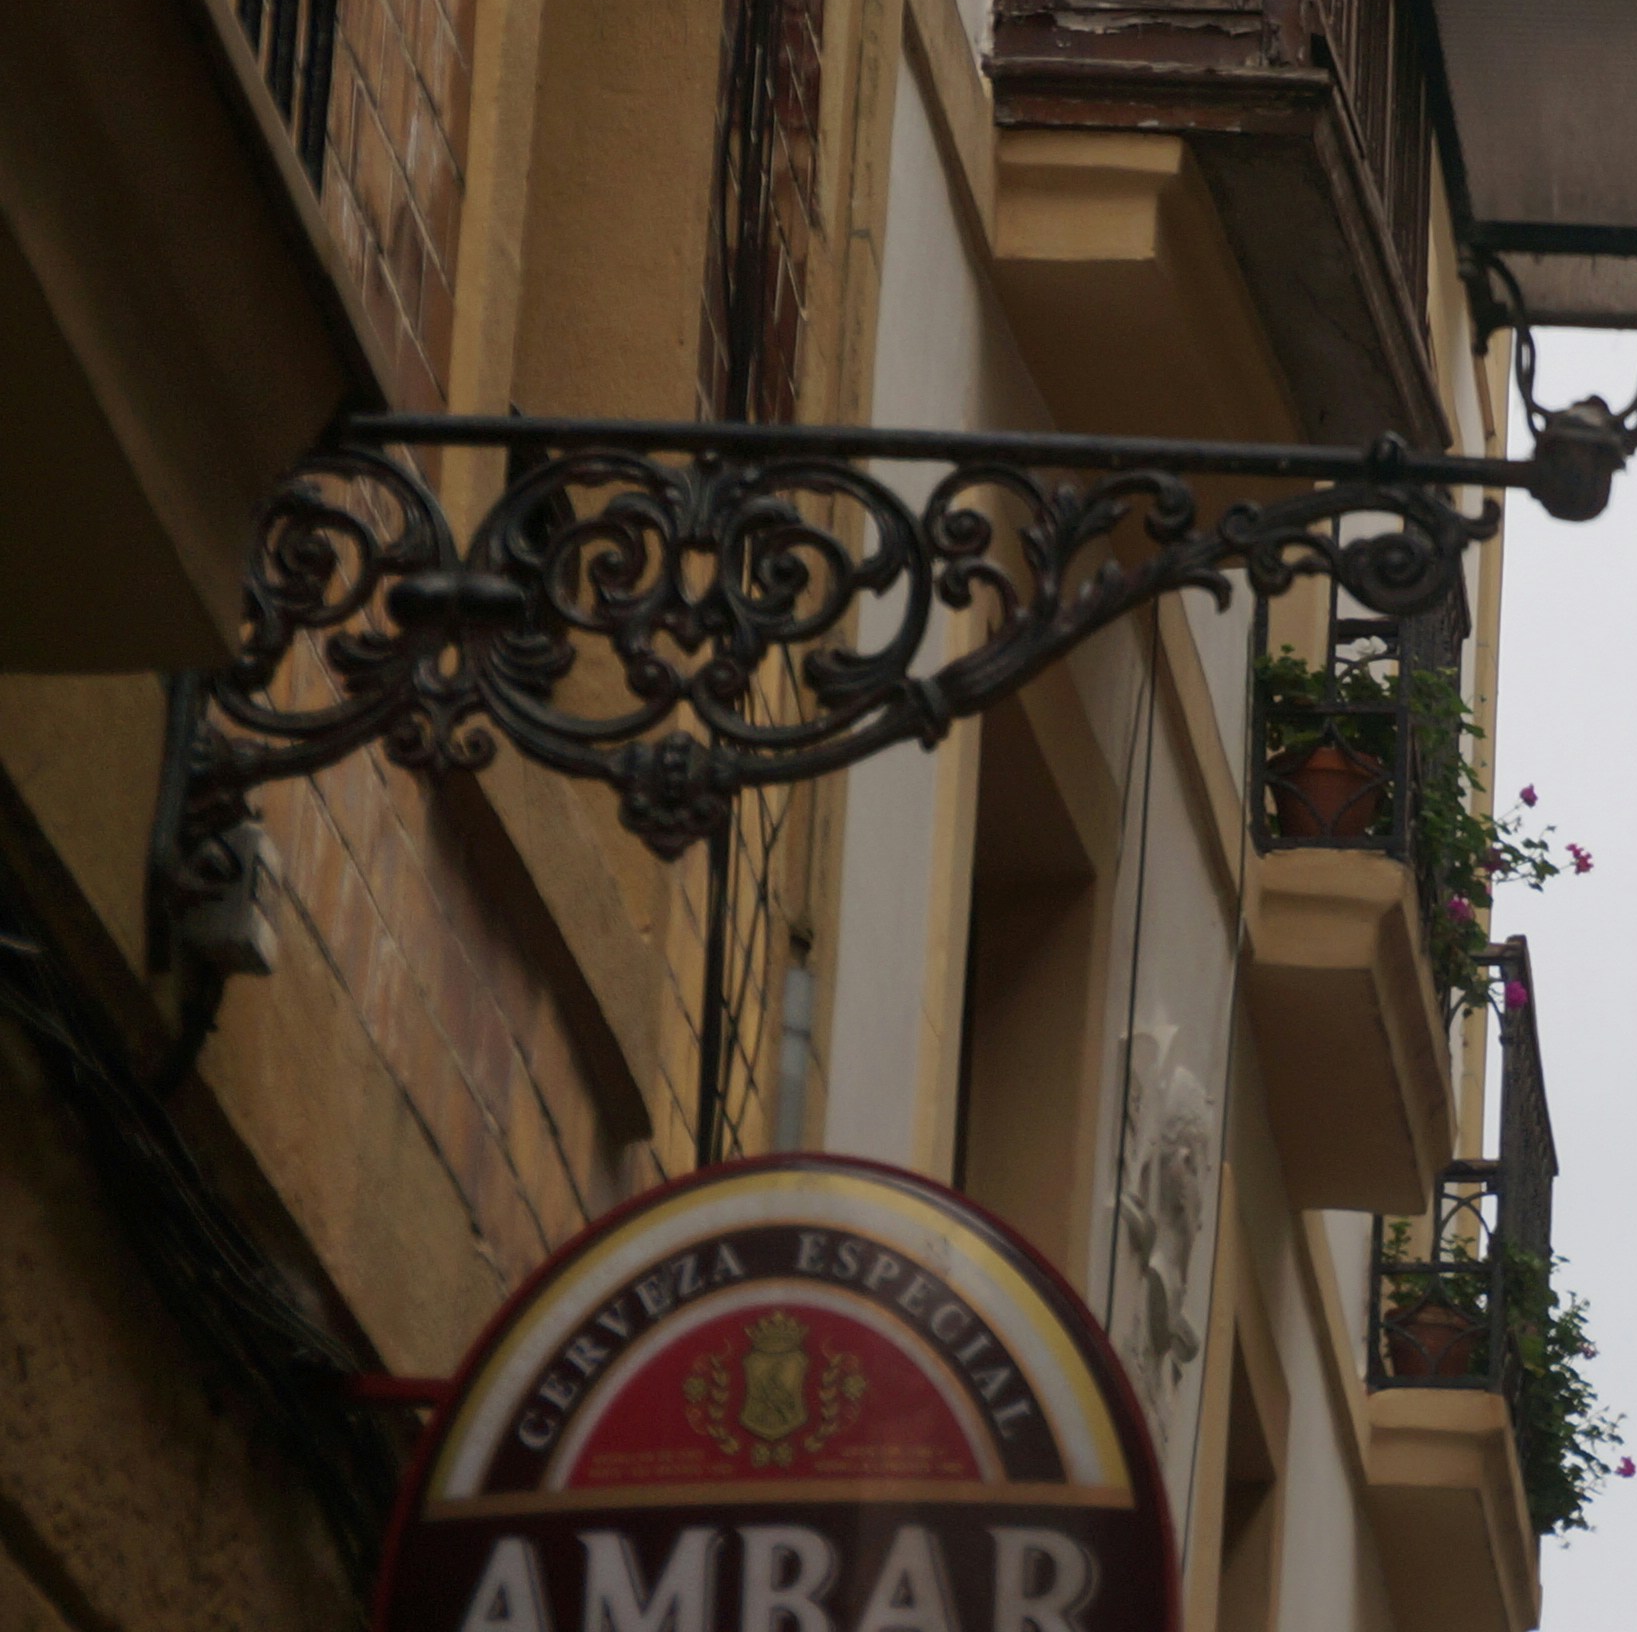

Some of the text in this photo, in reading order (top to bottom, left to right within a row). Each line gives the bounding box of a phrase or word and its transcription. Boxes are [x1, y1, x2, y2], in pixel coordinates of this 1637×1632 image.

[517, 1231, 1032, 1451] CERVEZA ESPECIAL
[460, 1525, 1092, 1632] AMBAR
